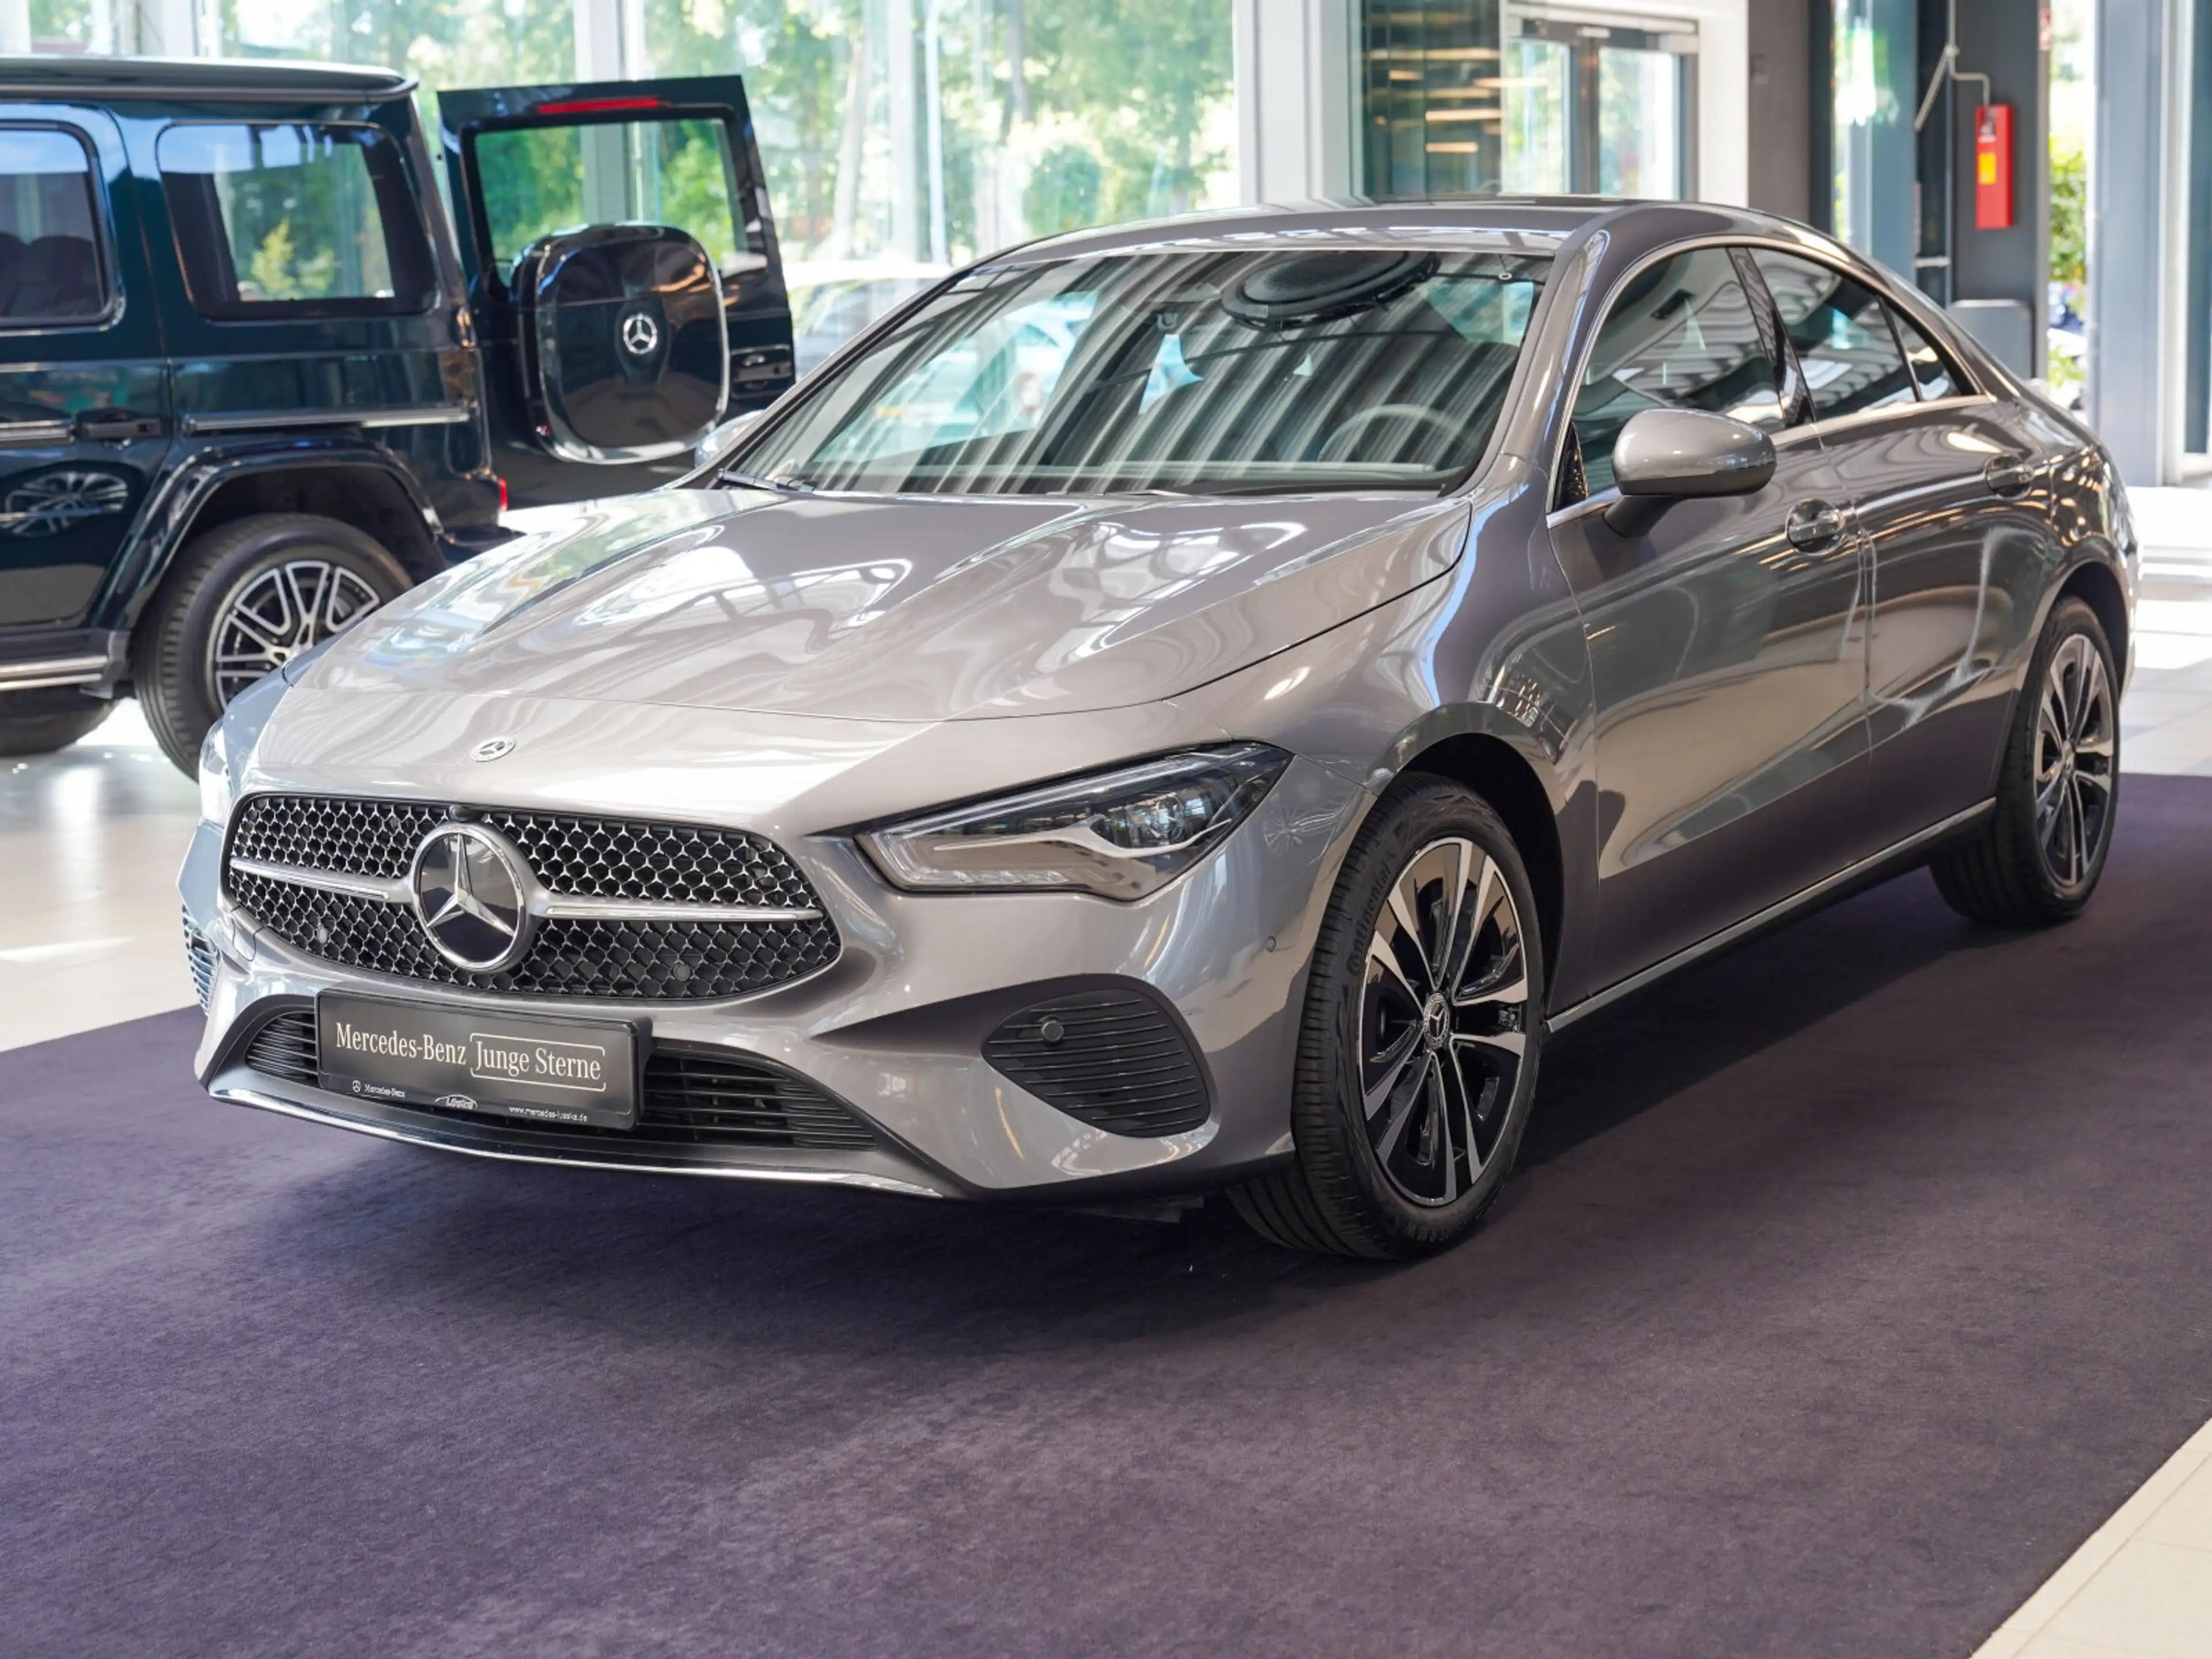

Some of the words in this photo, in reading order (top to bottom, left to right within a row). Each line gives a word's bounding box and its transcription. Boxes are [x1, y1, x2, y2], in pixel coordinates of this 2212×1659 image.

[1346, 859, 1392, 976] Continental
[335, 1021, 467, 1066] Mercedes-Benz
[475, 1040, 530, 1077] Junge
[535, 1047, 601, 1081] Sterne
